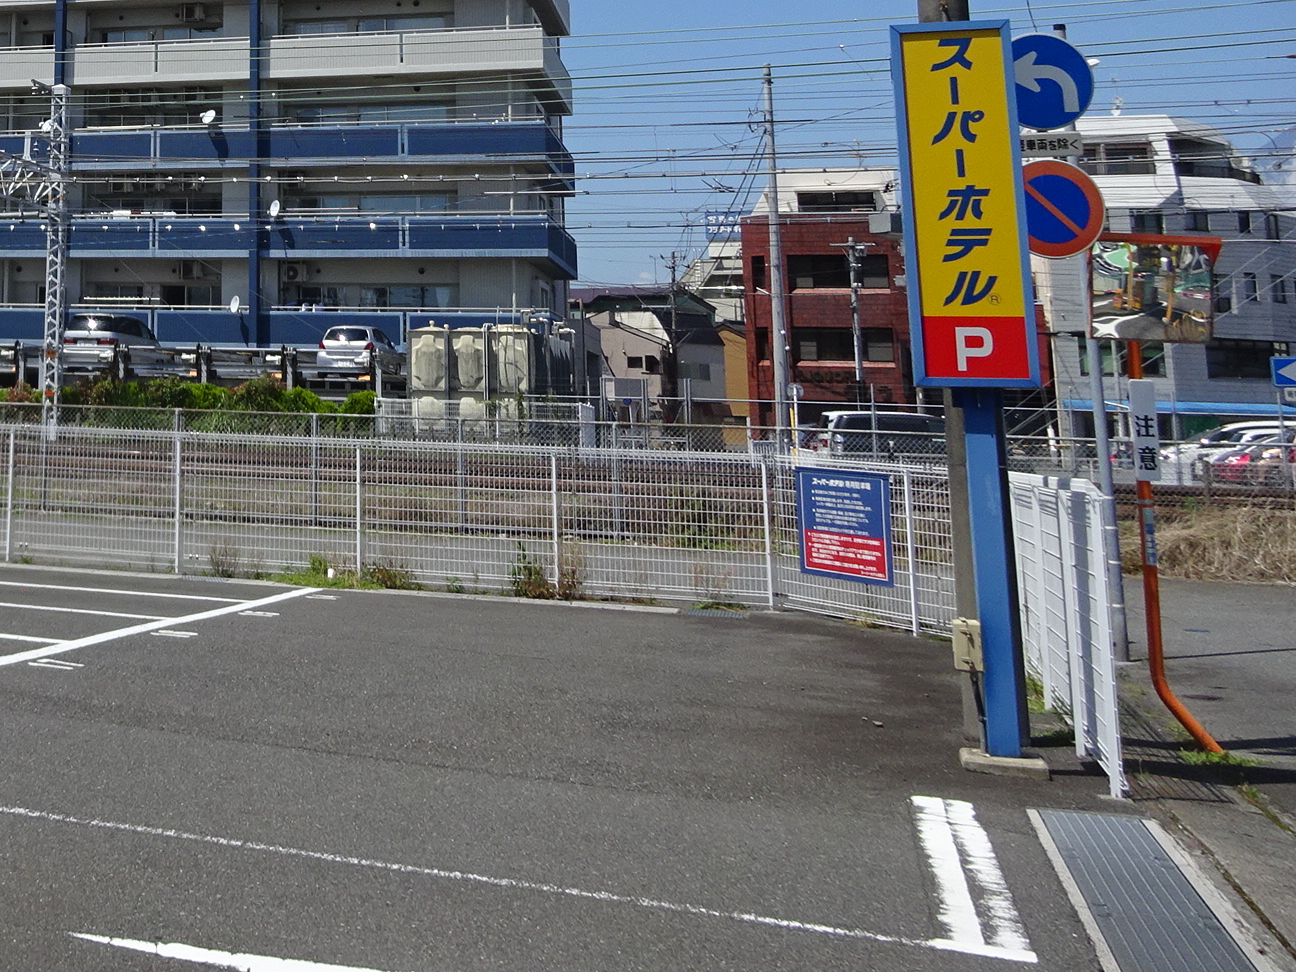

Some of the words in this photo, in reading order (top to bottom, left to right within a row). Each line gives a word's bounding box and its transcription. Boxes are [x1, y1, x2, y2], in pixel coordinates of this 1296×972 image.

[930, 38, 997, 307] スーパーホテル
[954, 326, 994, 372] P
[1134, 414, 1158, 471] 注意
